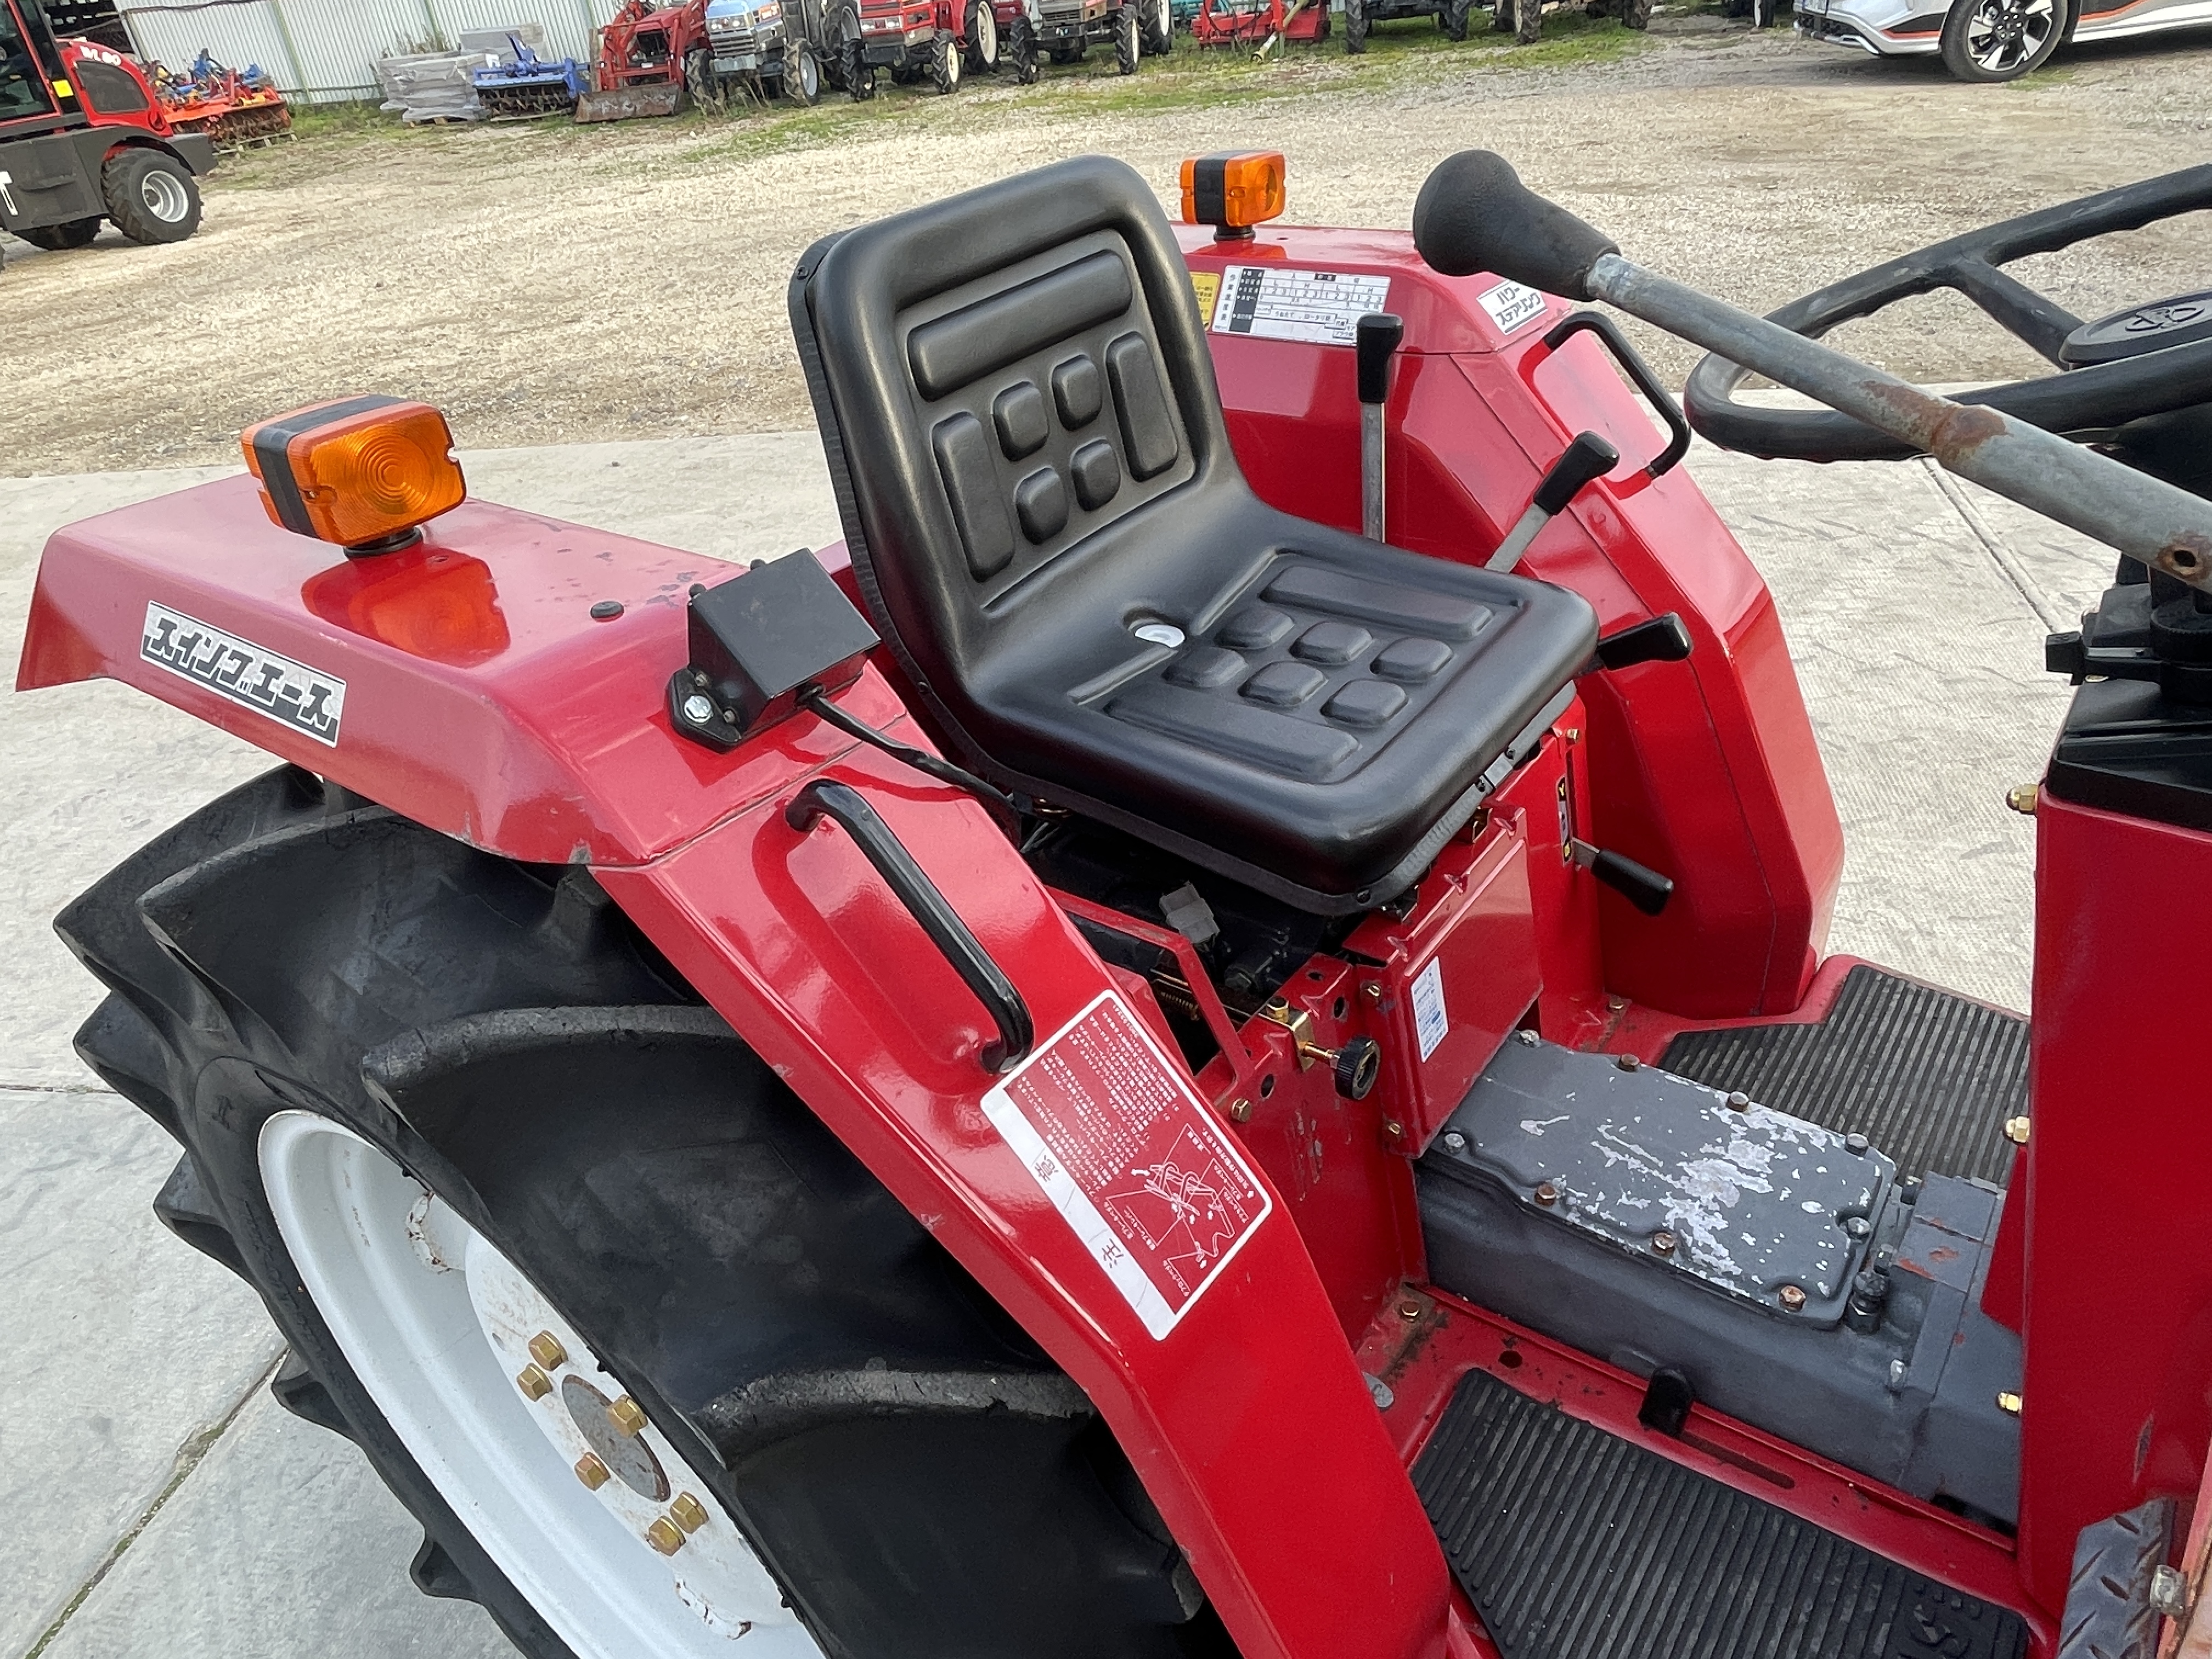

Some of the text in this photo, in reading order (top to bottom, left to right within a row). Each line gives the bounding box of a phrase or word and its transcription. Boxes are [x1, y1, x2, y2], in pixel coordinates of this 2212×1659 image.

[146, 616, 332, 731] スイングエース
